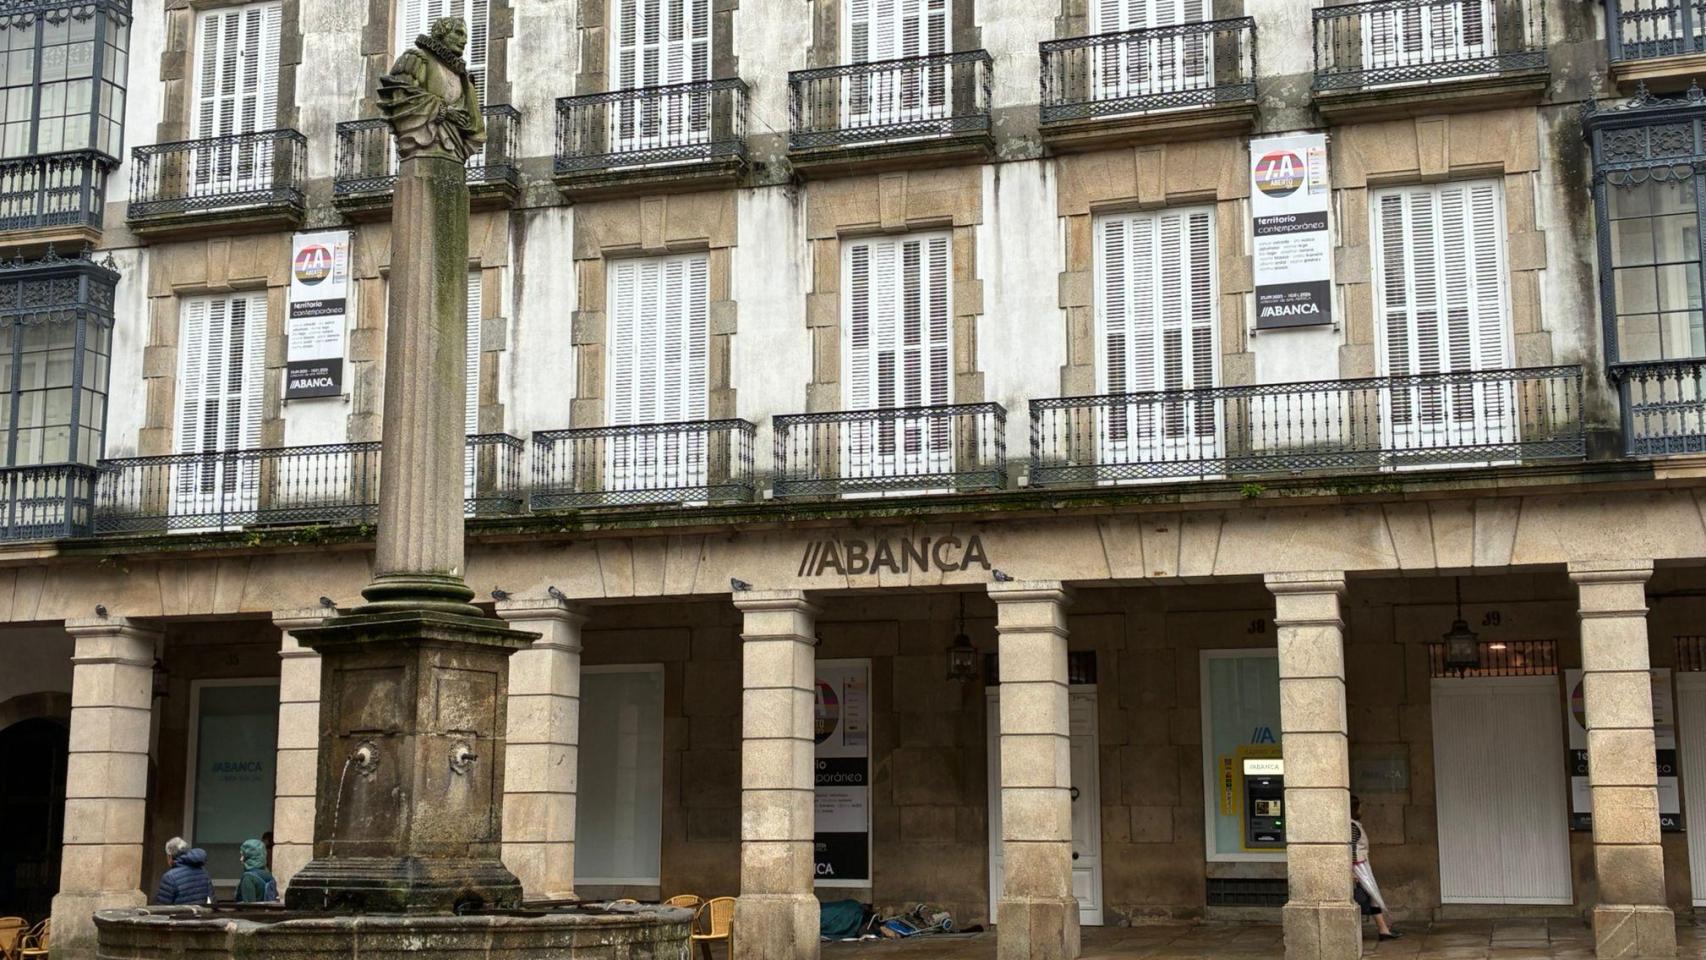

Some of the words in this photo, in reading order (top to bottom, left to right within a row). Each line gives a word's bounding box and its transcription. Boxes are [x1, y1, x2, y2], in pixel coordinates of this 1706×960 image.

[1258, 215, 1296, 225] territorio
[1258, 222, 1325, 234] contemporáneo
[293, 301, 323, 309] territorio
[293, 307, 343, 317] contemporáneo
